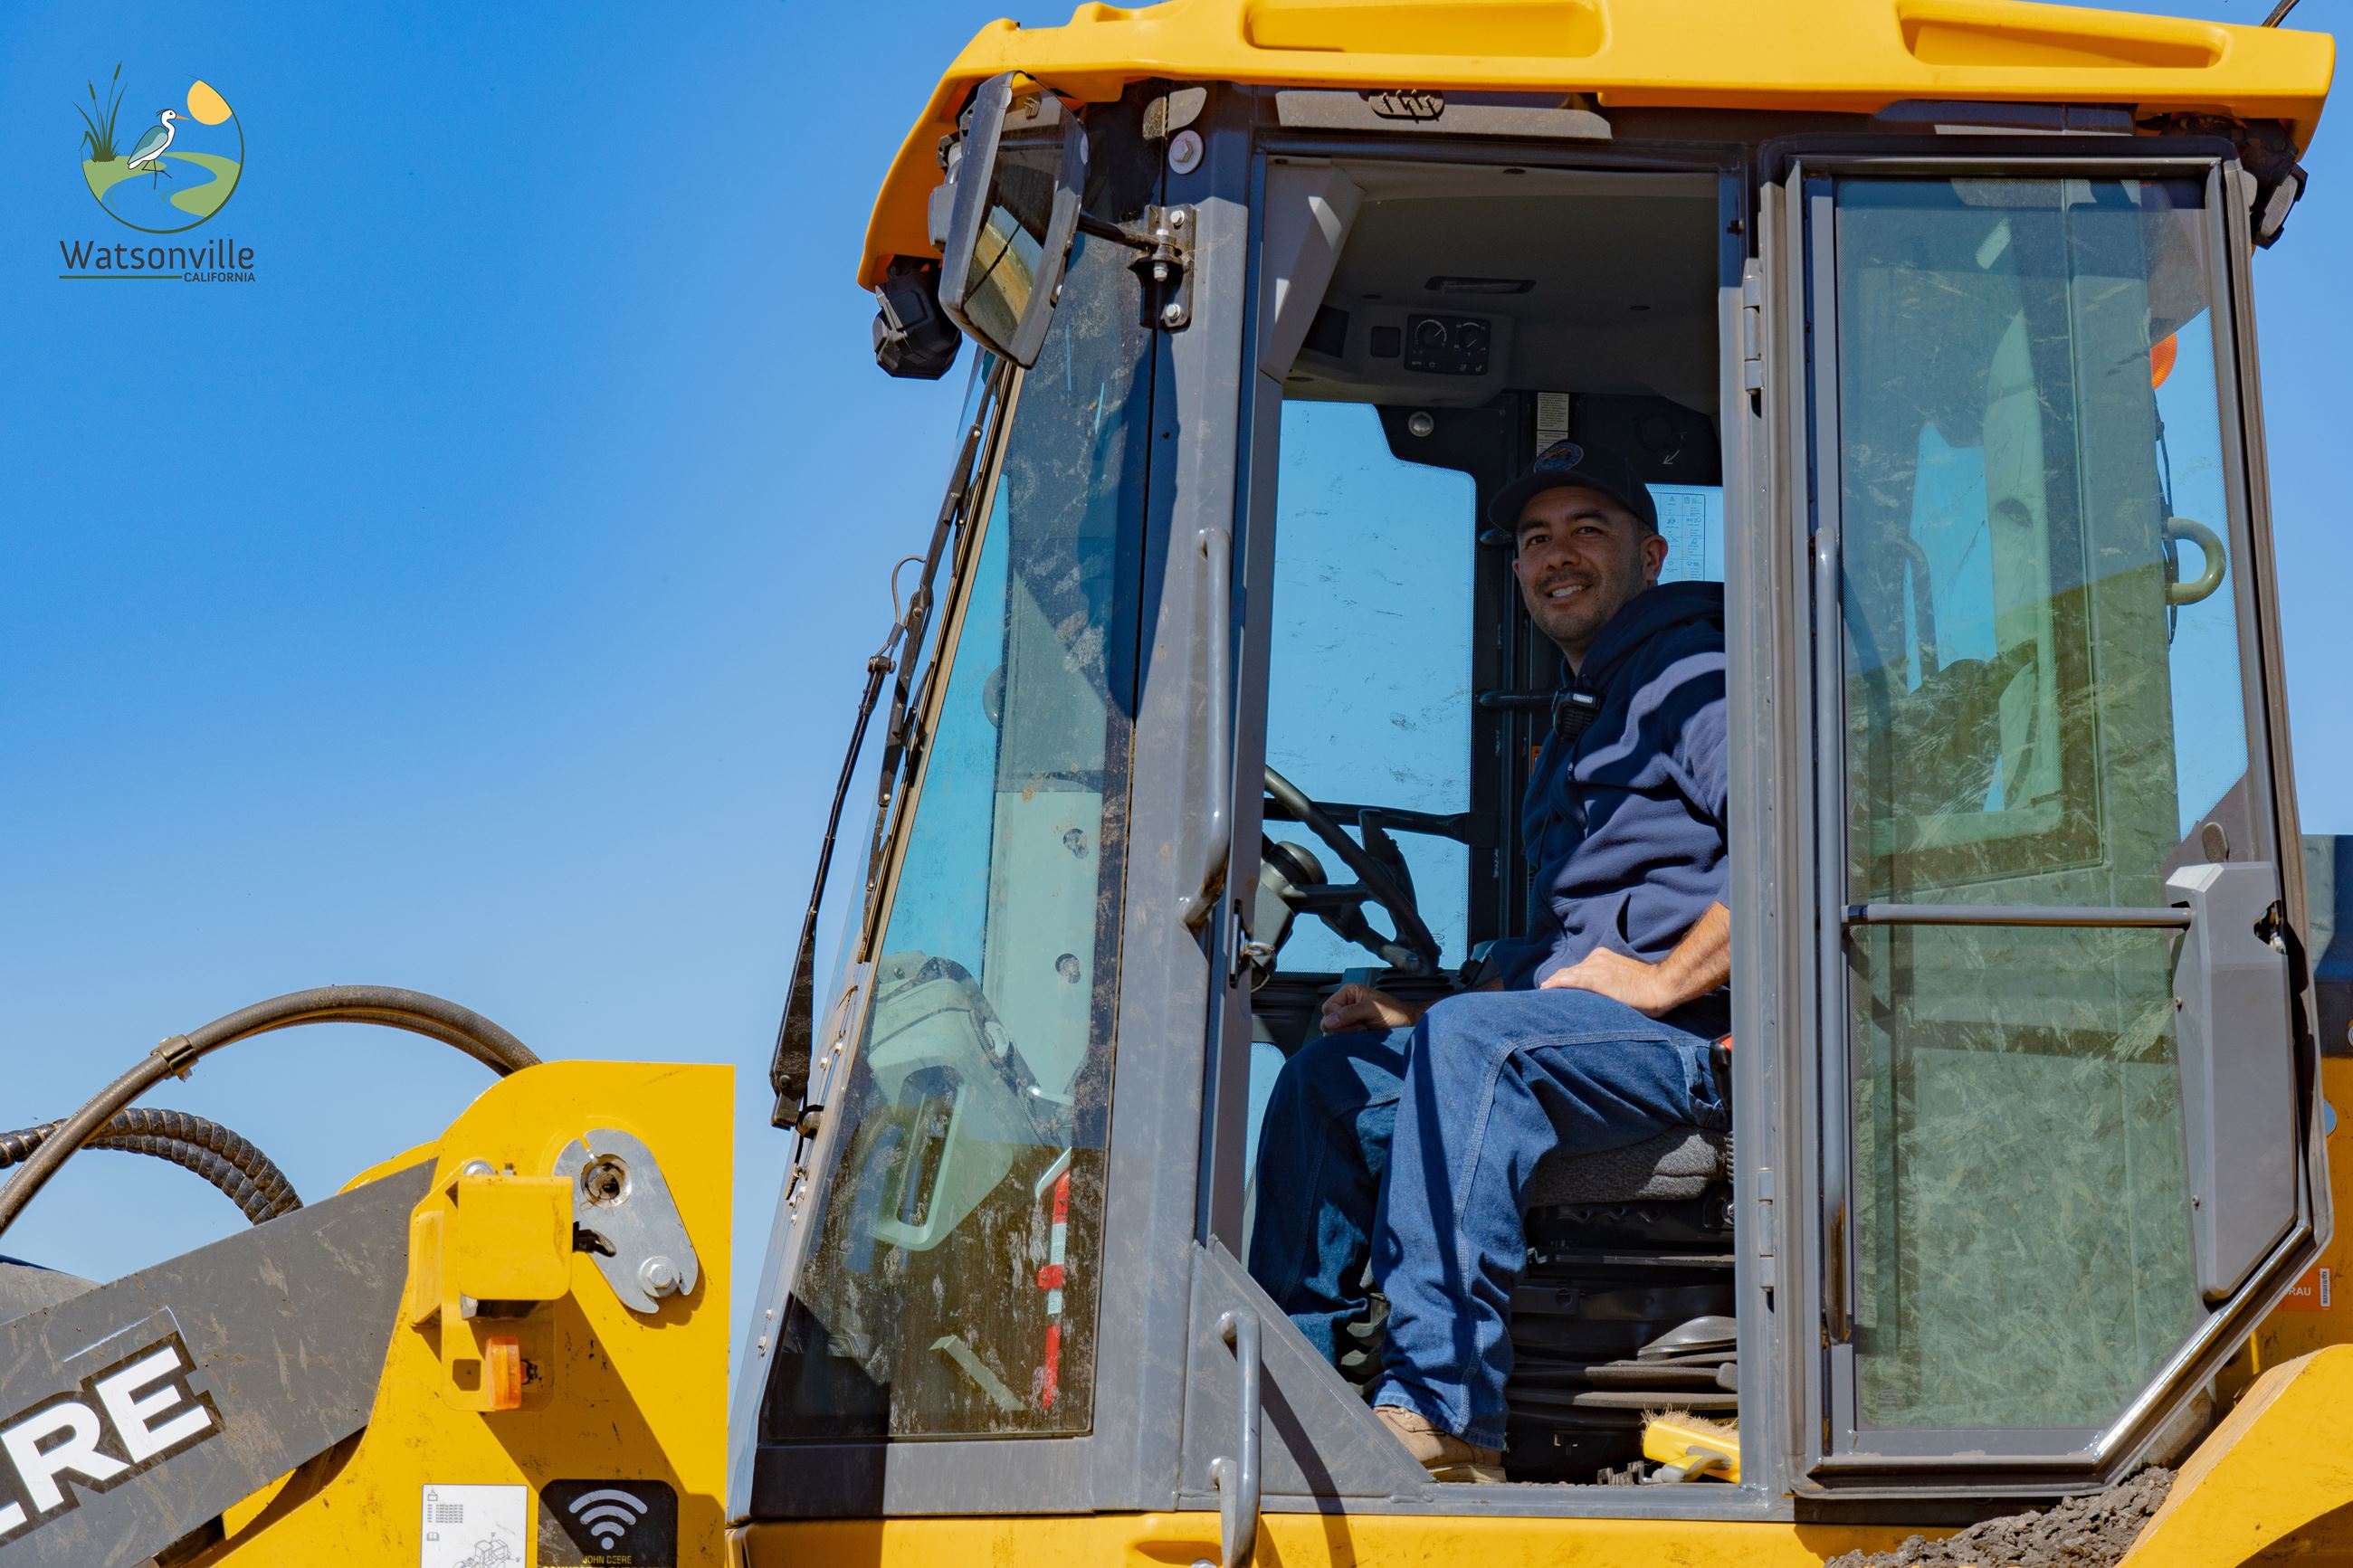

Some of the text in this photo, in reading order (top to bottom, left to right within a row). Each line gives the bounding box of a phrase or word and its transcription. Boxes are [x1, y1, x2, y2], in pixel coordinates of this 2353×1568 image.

[0, 1346, 213, 1535] RE
[582, 1554, 632, 1564] JOHN DEERE
